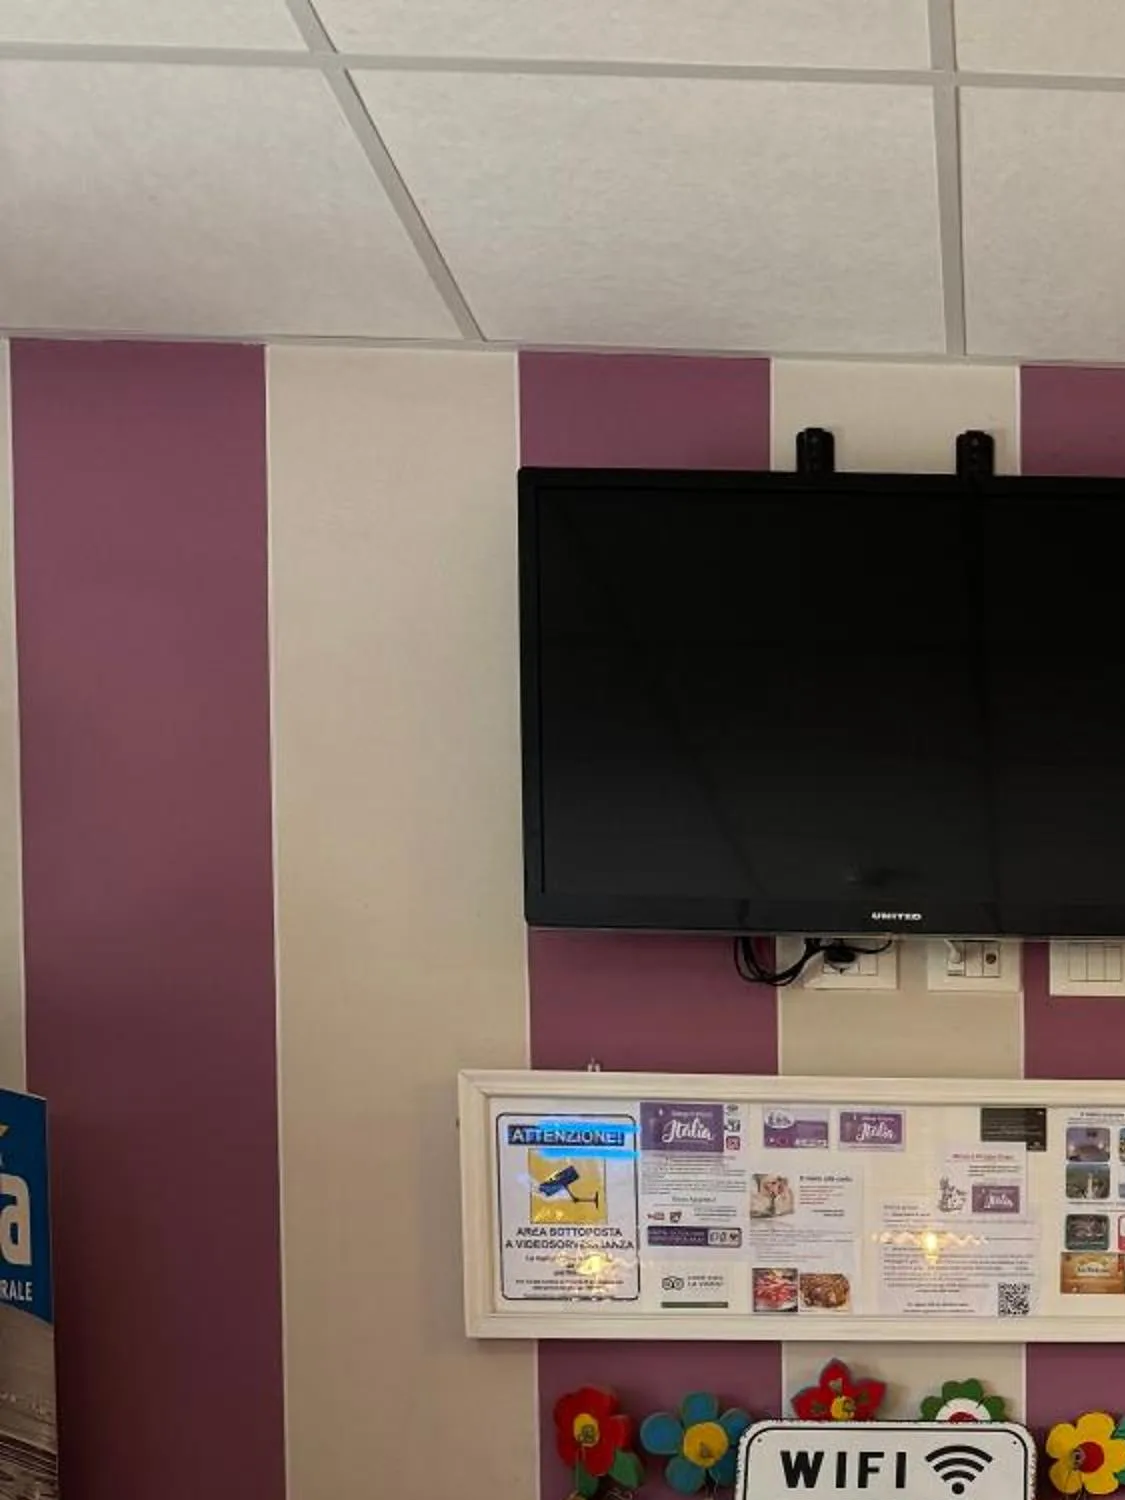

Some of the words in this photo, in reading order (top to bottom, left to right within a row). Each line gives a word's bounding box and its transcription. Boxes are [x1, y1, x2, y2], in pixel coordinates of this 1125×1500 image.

[871, 911, 922, 921] UNITED
[516, 1226, 547, 1237] AREA
[549, 1226, 623, 1237] SOTTOPOSTA
[780, 1450, 907, 1489] WIFI
